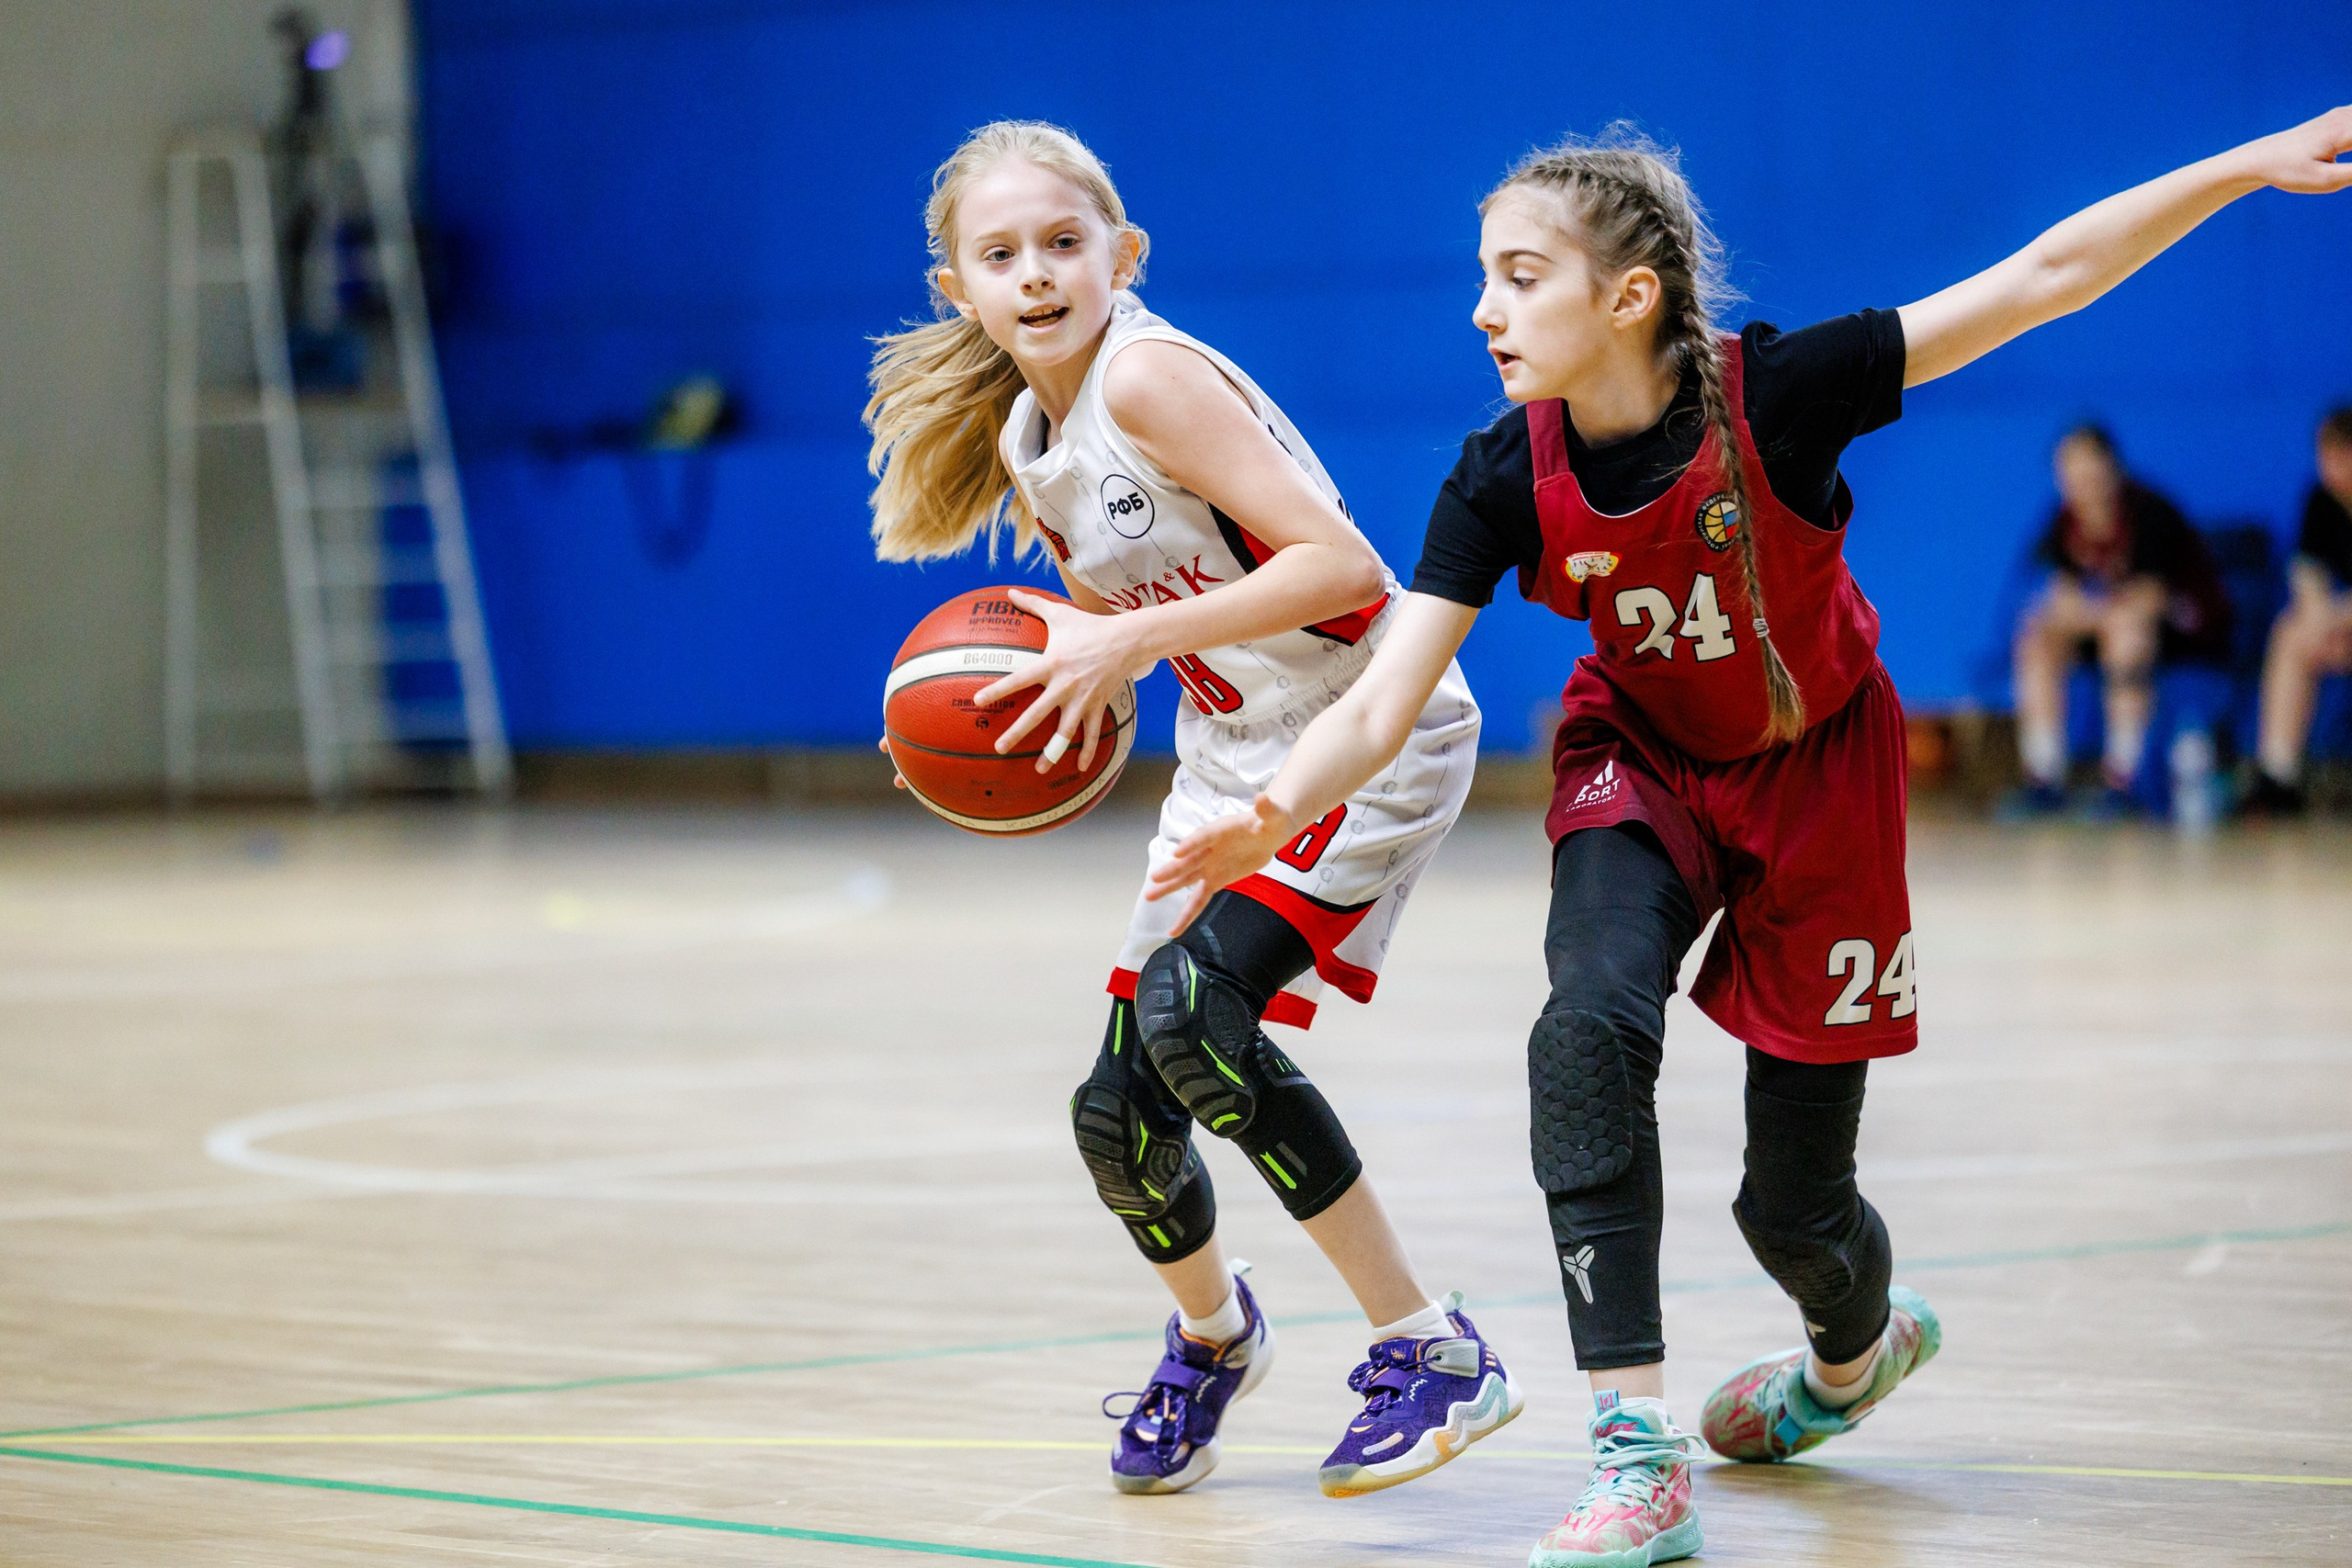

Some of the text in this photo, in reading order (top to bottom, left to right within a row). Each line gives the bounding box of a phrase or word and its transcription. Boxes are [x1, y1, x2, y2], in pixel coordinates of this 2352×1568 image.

[1107, 491, 1145, 521] РФБ
[968, 616, 1023, 626] APPROVED
[1614, 571, 1738, 663] 24
[963, 652, 1013, 666] BG4000
[1566, 778, 1621, 809] PORT
[1823, 930, 1917, 1027] 24
